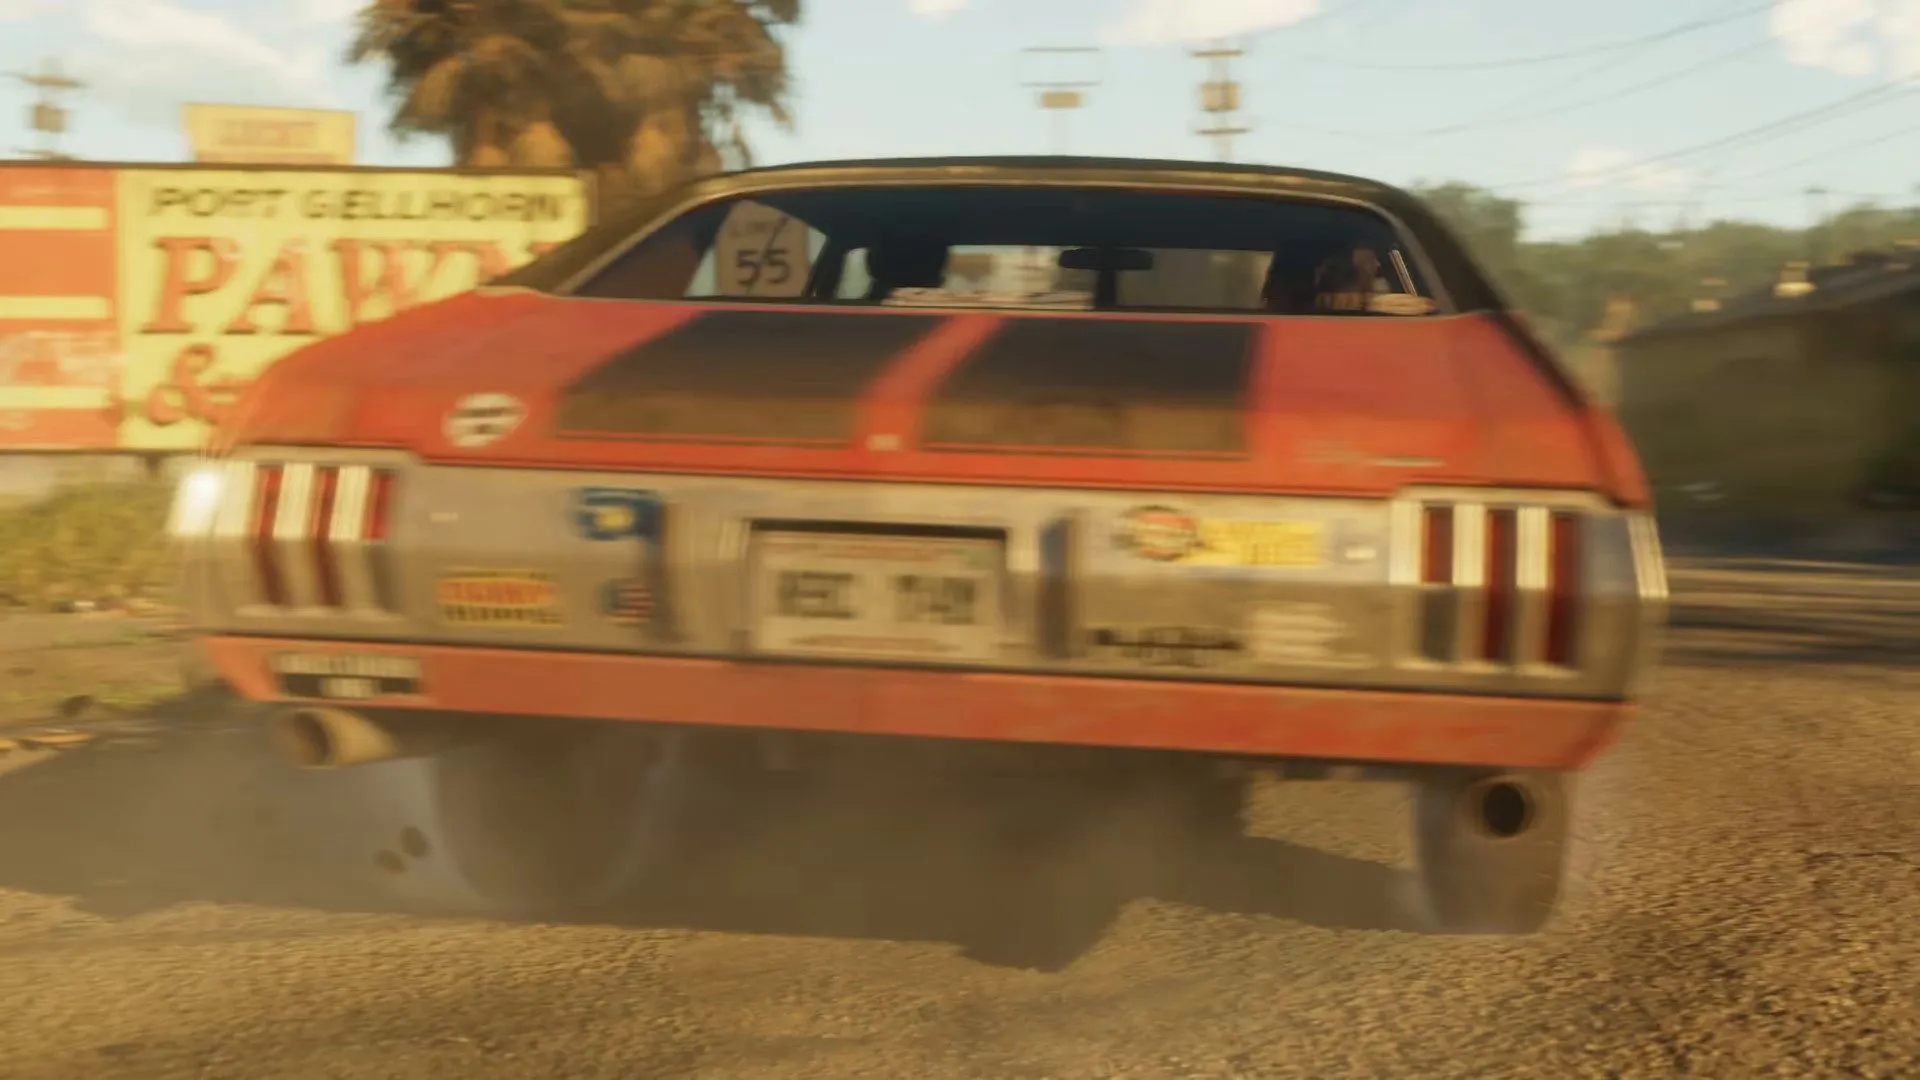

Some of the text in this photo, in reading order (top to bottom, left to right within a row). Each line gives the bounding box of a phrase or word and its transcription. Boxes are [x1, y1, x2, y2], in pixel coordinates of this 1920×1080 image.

[153, 187, 562, 221] PORT GELLHORN
[735, 247, 792, 286] 55
